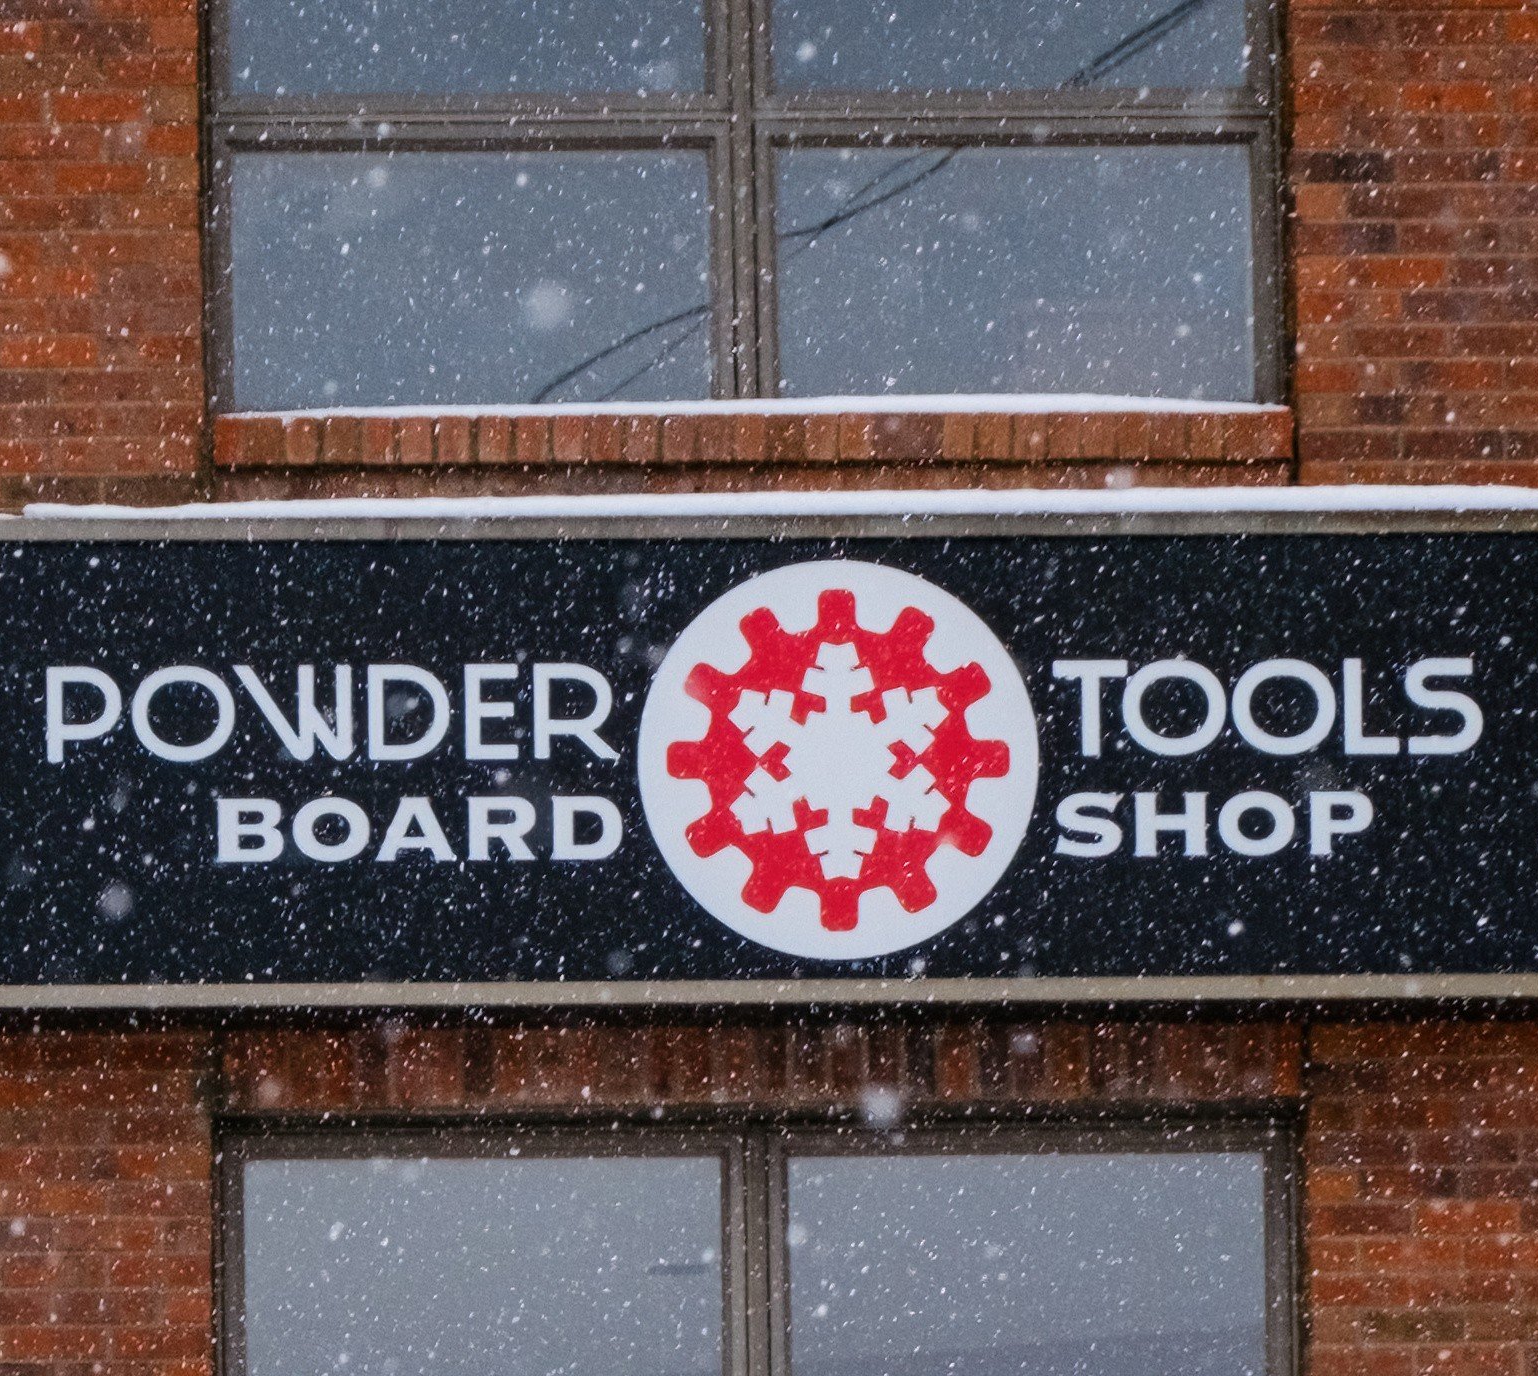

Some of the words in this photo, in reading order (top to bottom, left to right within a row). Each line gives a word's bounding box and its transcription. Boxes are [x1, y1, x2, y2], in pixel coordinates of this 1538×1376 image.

[45, 662, 622, 763] POWDER
[1052, 657, 1484, 757] TOOLS
[215, 795, 624, 862] BOARD
[1053, 790, 1374, 857] SHOP
